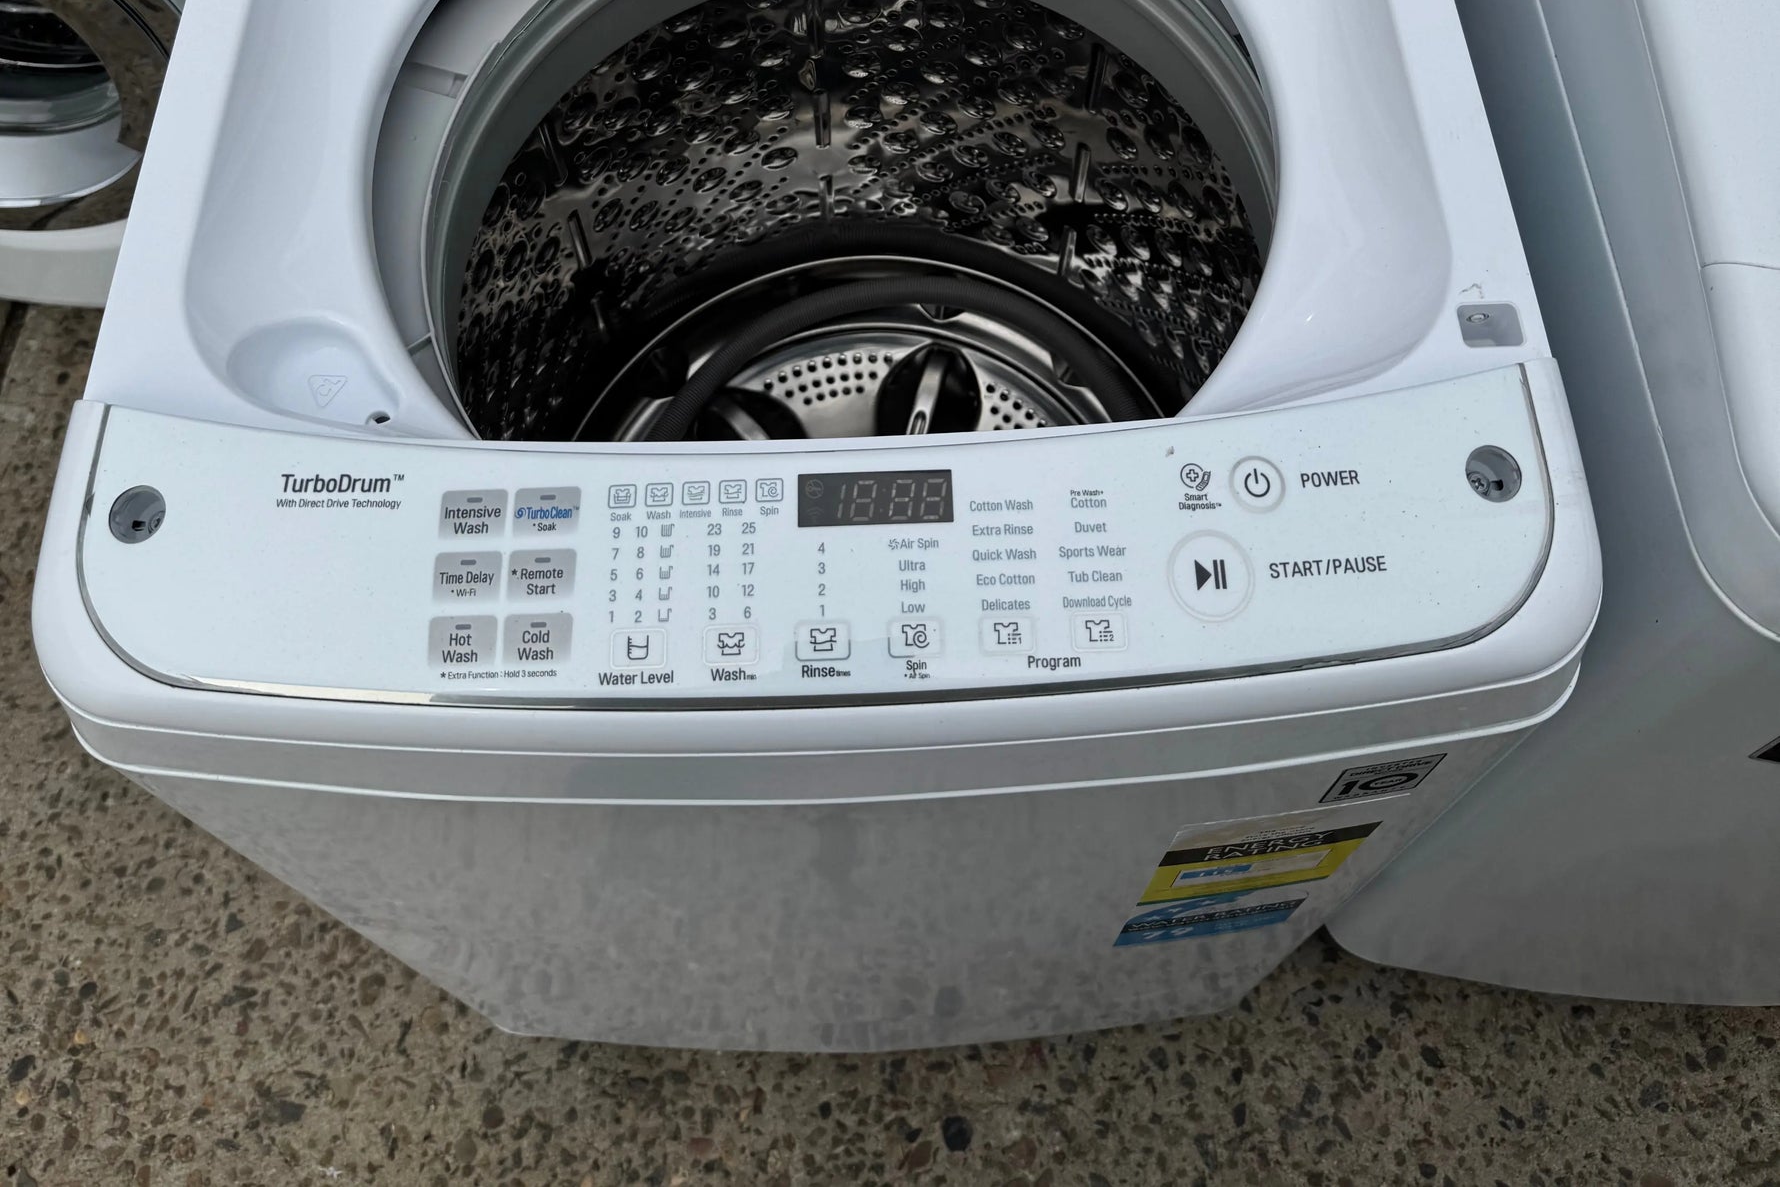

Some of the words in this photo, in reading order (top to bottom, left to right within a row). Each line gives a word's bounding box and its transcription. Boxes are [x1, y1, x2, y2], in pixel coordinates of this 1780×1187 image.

[1300, 469, 1360, 489] POWER
[1069, 489, 1081, 497] Pre
[1184, 493, 1209, 502] Smart
[276, 498, 297, 508] With
[299, 498, 325, 508] Direct
[326, 498, 349, 508] Drive
[352, 498, 402, 510] Technology
[969, 500, 1003, 512] Cotton
[1004, 499, 1034, 511] Wash
[1070, 497, 1107, 509] Cotton
[444, 505, 502, 520] Intensive
[610, 512, 632, 522] Soak
[646, 510, 672, 520] Wash
[679, 509, 712, 519] Intensive
[722, 507, 743, 517] Rinse
[760, 506, 779, 516] Spin
[453, 521, 489, 535] Wash
[537, 522, 557, 532] Soak
[612, 526, 621, 539] 9
[635, 525, 649, 538] 10
[707, 523, 722, 536] 23
[741, 522, 757, 534] 25
[972, 524, 1001, 536] Extra
[1003, 523, 1034, 535] Rinse
[1074, 521, 1107, 533] Duvet
[708, 544, 721, 557] 19
[742, 542, 755, 555] 21
[817, 542, 826, 554] 4
[899, 538, 915, 549] Air
[917, 537, 940, 551] Spin
[611, 547, 620, 560] 7
[636, 546, 645, 559] 8
[972, 549, 1003, 562] Quick
[1005, 548, 1037, 561] Wash
[1058, 546, 1095, 560] Sports
[1097, 545, 1127, 558] Wear
[707, 563, 720, 576] 14
[742, 562, 755, 575] 17
[817, 562, 826, 575] 3
[898, 559, 927, 572] Ultra
[1268, 555, 1388, 580] START/PAUSE
[439, 572, 464, 585] Time
[466, 571, 495, 586] Delay
[520, 567, 564, 580] Remote
[610, 569, 618, 581] 5
[635, 567, 644, 581] 6
[976, 574, 997, 586] Eco
[998, 573, 1036, 586] Cotton
[1067, 571, 1090, 583] Tub
[1091, 570, 1123, 583] Clean
[456, 587, 477, 597] Wi-Fi
[526, 583, 556, 596] Start
[707, 585, 720, 598] 10
[741, 584, 755, 597] 12
[818, 583, 826, 596] 2
[900, 579, 926, 593] High
[608, 589, 617, 602] 3
[634, 588, 643, 602] 4
[901, 601, 926, 614] Low
[981, 599, 1031, 612] Delicates
[1062, 595, 1106, 609] Download
[1107, 594, 1132, 610] Cycle
[608, 610, 614, 623] 1
[634, 610, 643, 623] 2
[708, 607, 717, 620] 3
[743, 606, 752, 619] 6
[819, 604, 826, 617] 1
[449, 632, 472, 647] Hot
[521, 629, 551, 644] Cold
[441, 649, 479, 663] Wash
[517, 647, 555, 661] Wash
[906, 659, 928, 675] Spin
[1027, 655, 1082, 671] Program
[447, 671, 467, 680] Extra
[468, 670, 499, 680] Function
[504, 670, 520, 679] Hold
[521, 669, 527, 678] 3
[527, 669, 558, 678] seconds
[598, 672, 638, 687] Water
[640, 670, 675, 684] Level
[710, 667, 747, 682] Wash
[801, 665, 836, 679] Rinse
[1206, 830, 1335, 855] ENERGY
[1203, 840, 1322, 862] RATING
